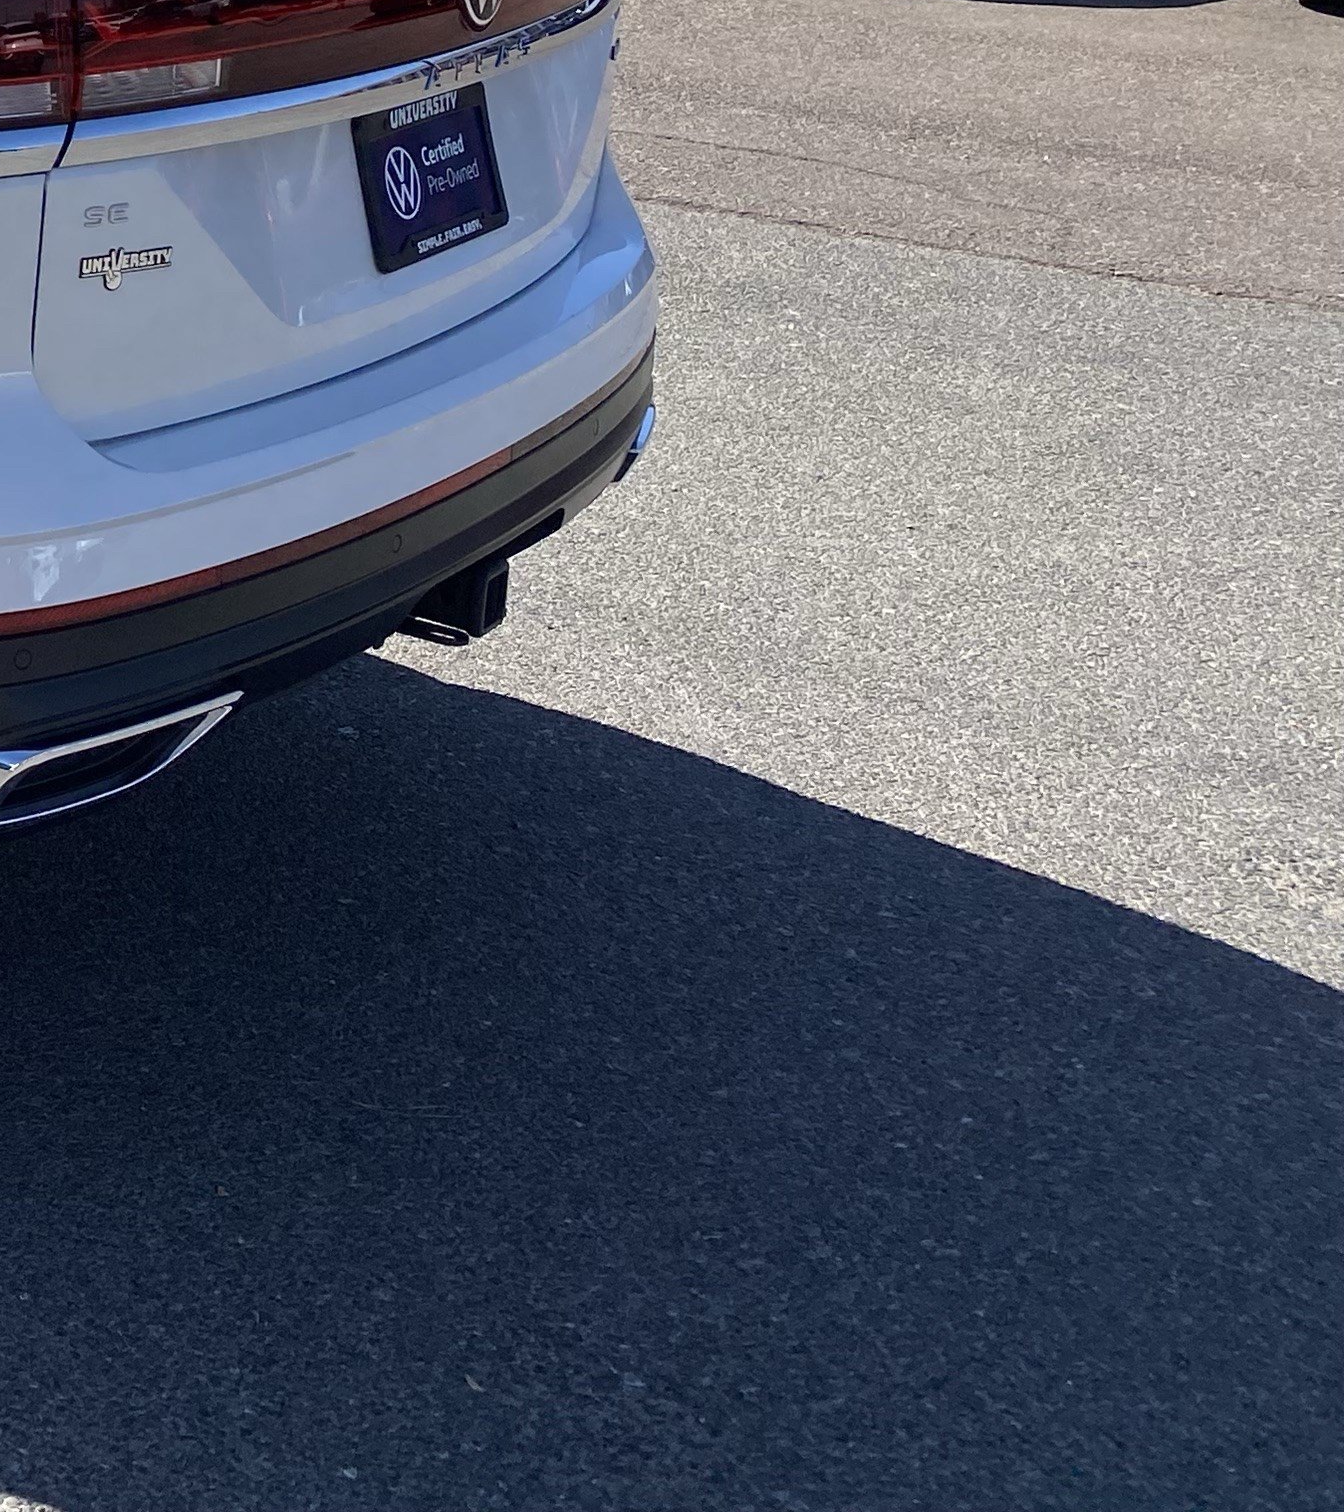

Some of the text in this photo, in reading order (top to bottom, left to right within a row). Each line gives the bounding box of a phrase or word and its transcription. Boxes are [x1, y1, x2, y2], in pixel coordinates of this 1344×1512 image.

[389, 90, 458, 129] UNIVERSITY
[421, 133, 465, 166] Certified
[427, 158, 480, 196] Pre-Owned
[83, 202, 130, 228] SE
[81, 246, 173, 276] UNIVERSITY
